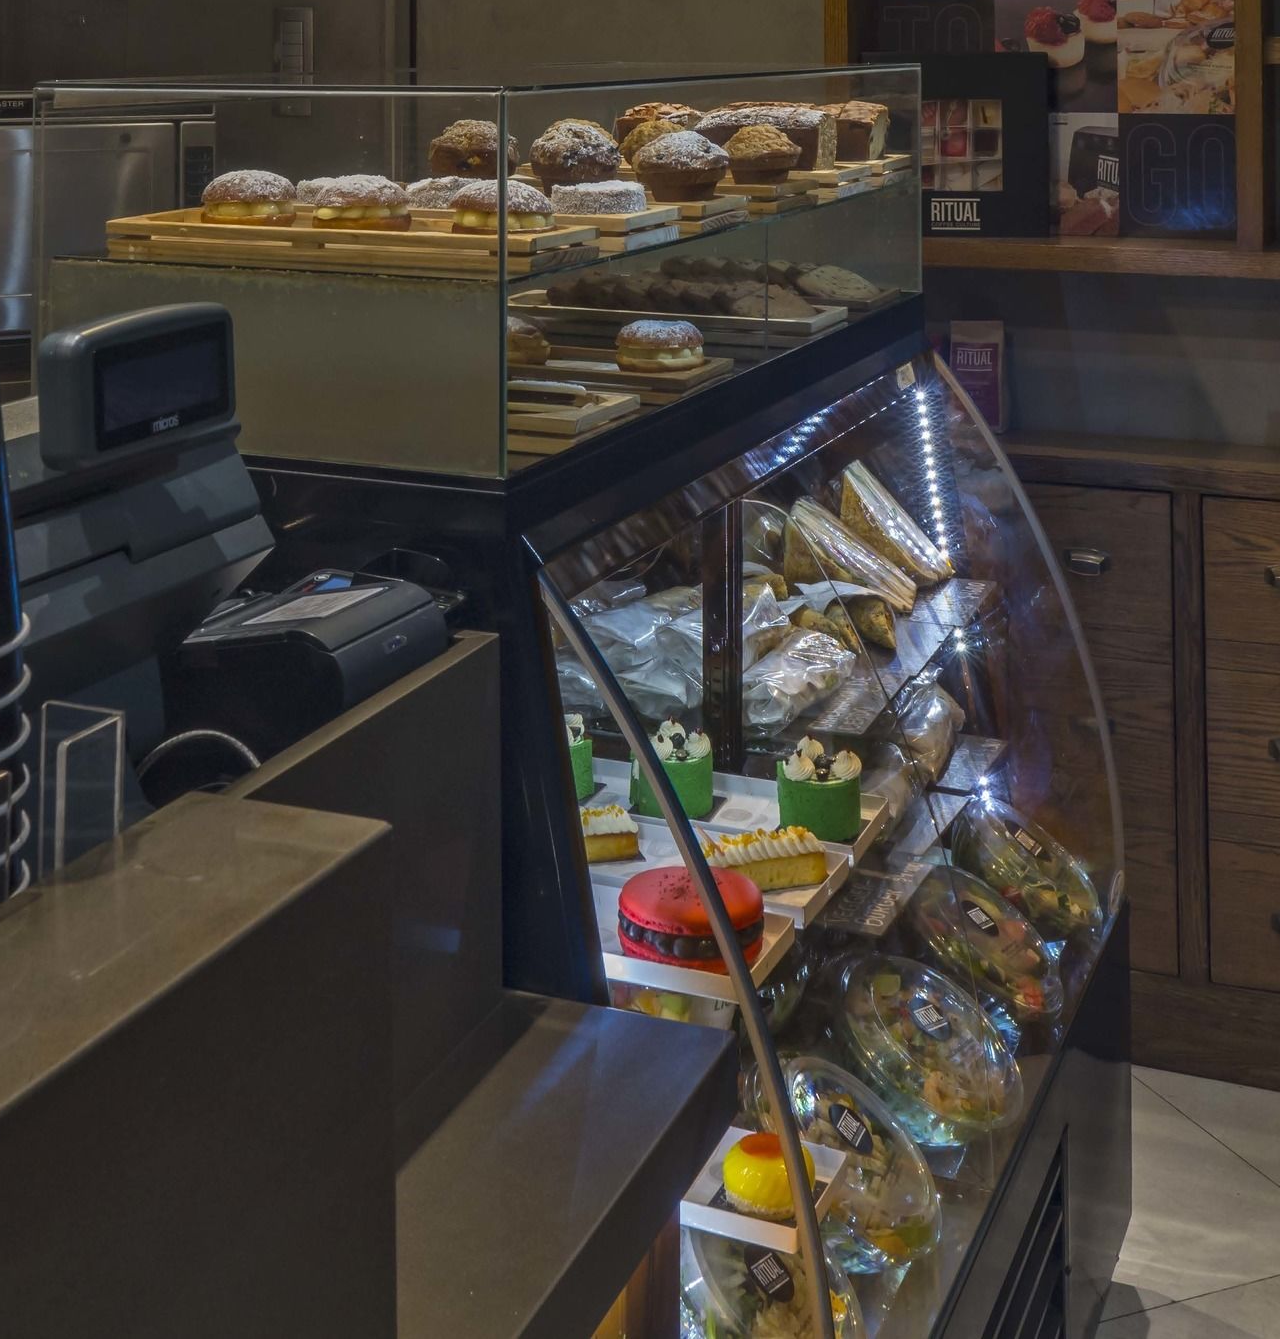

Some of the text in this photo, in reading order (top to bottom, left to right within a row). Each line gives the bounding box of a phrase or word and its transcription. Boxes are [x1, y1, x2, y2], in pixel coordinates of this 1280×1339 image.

[931, 200, 981, 222] RITUAL
[956, 350, 992, 365] RITUAL
[153, 413, 180, 433] micros
[838, 1112, 863, 1141] RITUAL
[754, 1256, 785, 1286] RITUAL
